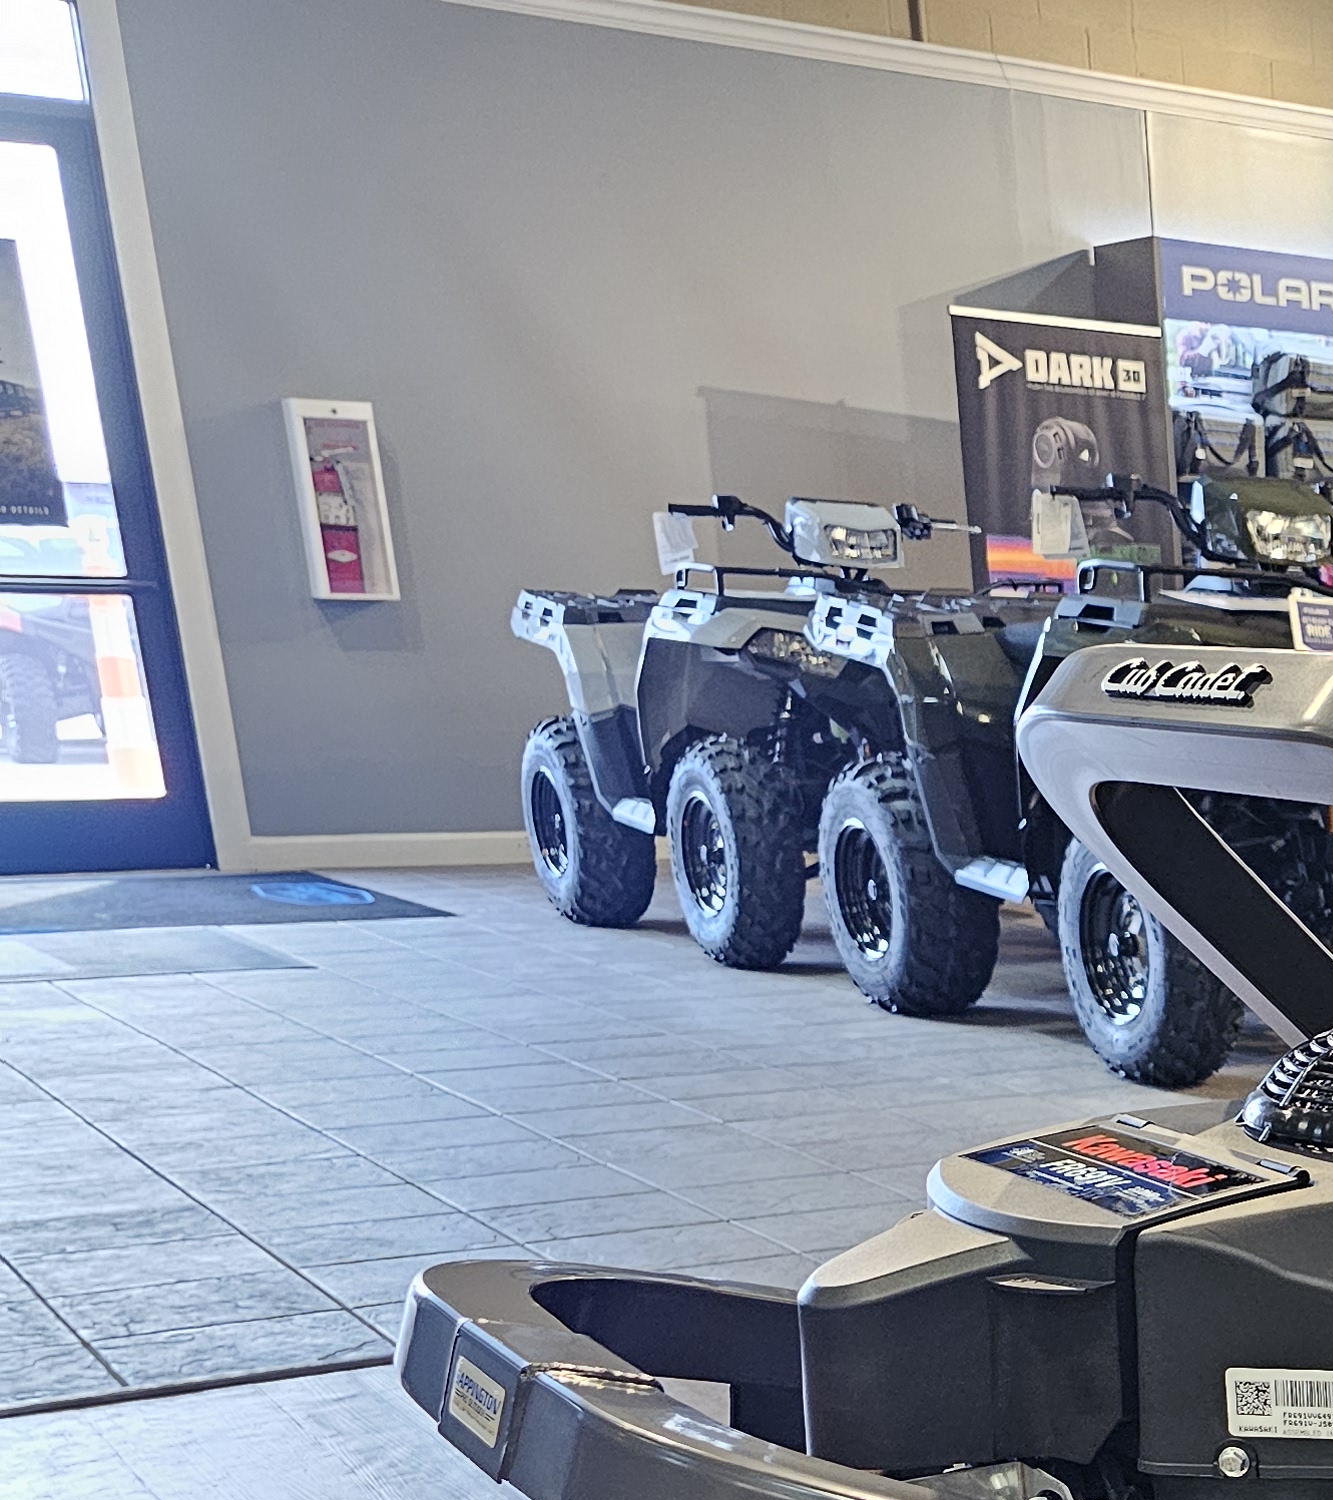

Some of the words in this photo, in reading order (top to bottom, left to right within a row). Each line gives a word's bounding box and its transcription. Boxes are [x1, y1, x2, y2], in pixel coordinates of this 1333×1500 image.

[1024, 349, 1115, 389] DARK
[1122, 368, 1141, 383] 30
[1156, 660, 1268, 703] Cadet
[1040, 1159, 1132, 1188] FR691V
[1061, 1134, 1228, 1188] Kawasaki
[1239, 1426, 1278, 1434] KAWASAKI
